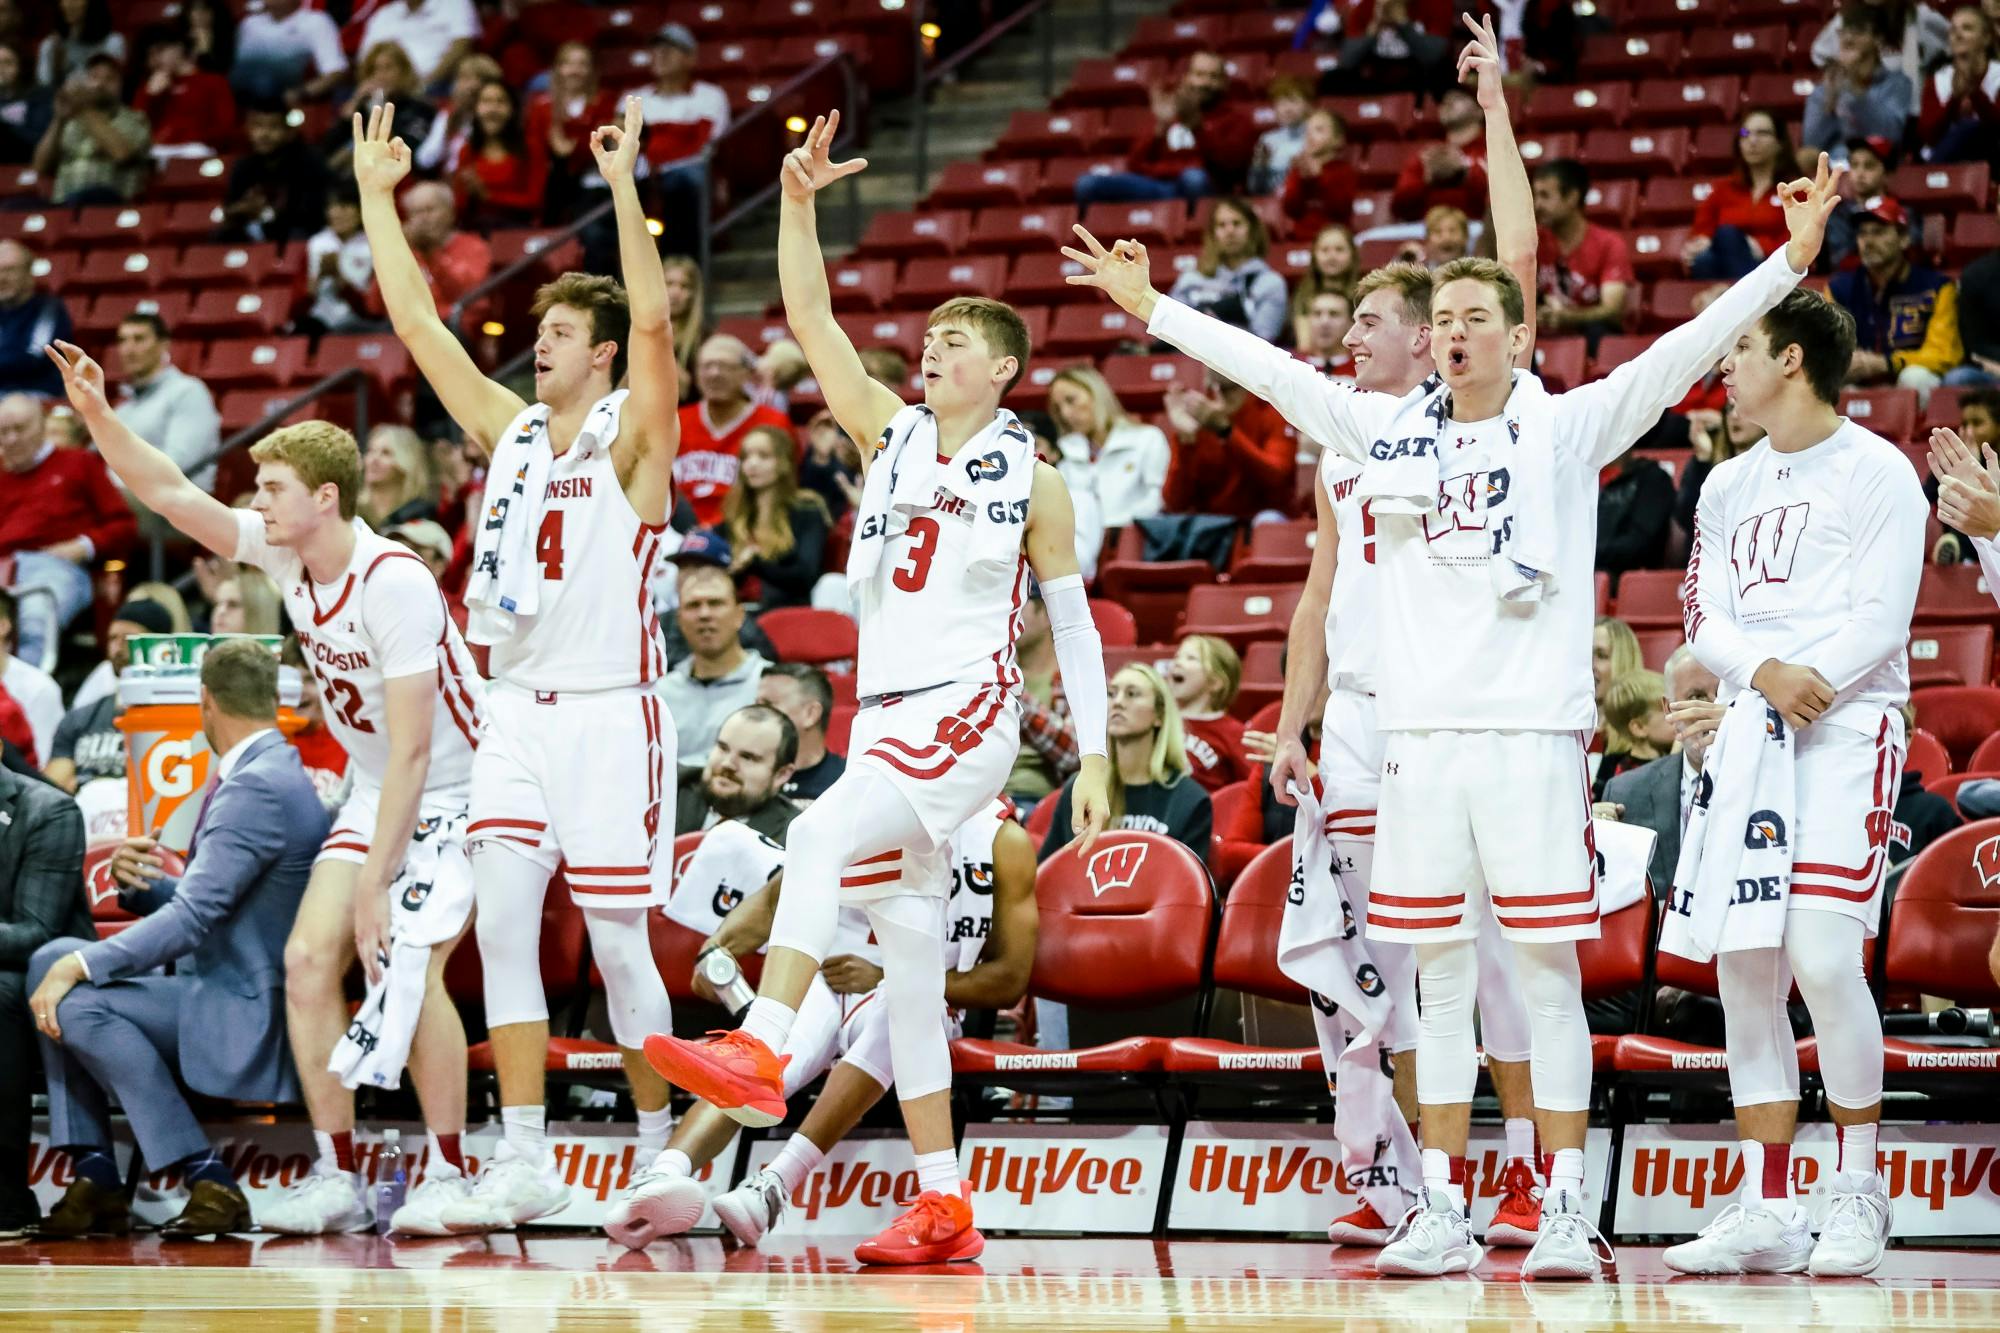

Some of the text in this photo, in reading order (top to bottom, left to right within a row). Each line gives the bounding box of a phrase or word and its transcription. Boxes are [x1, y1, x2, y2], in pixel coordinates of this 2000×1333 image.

[536, 510, 565, 581] 4
[892, 516, 940, 593] 3
[147, 740, 193, 798] G
[995, 1054, 1078, 1069] WISCONSIN
[1218, 1053, 1303, 1069] WISCONSIN
[1907, 1052, 1997, 1069] WISCONSIN
